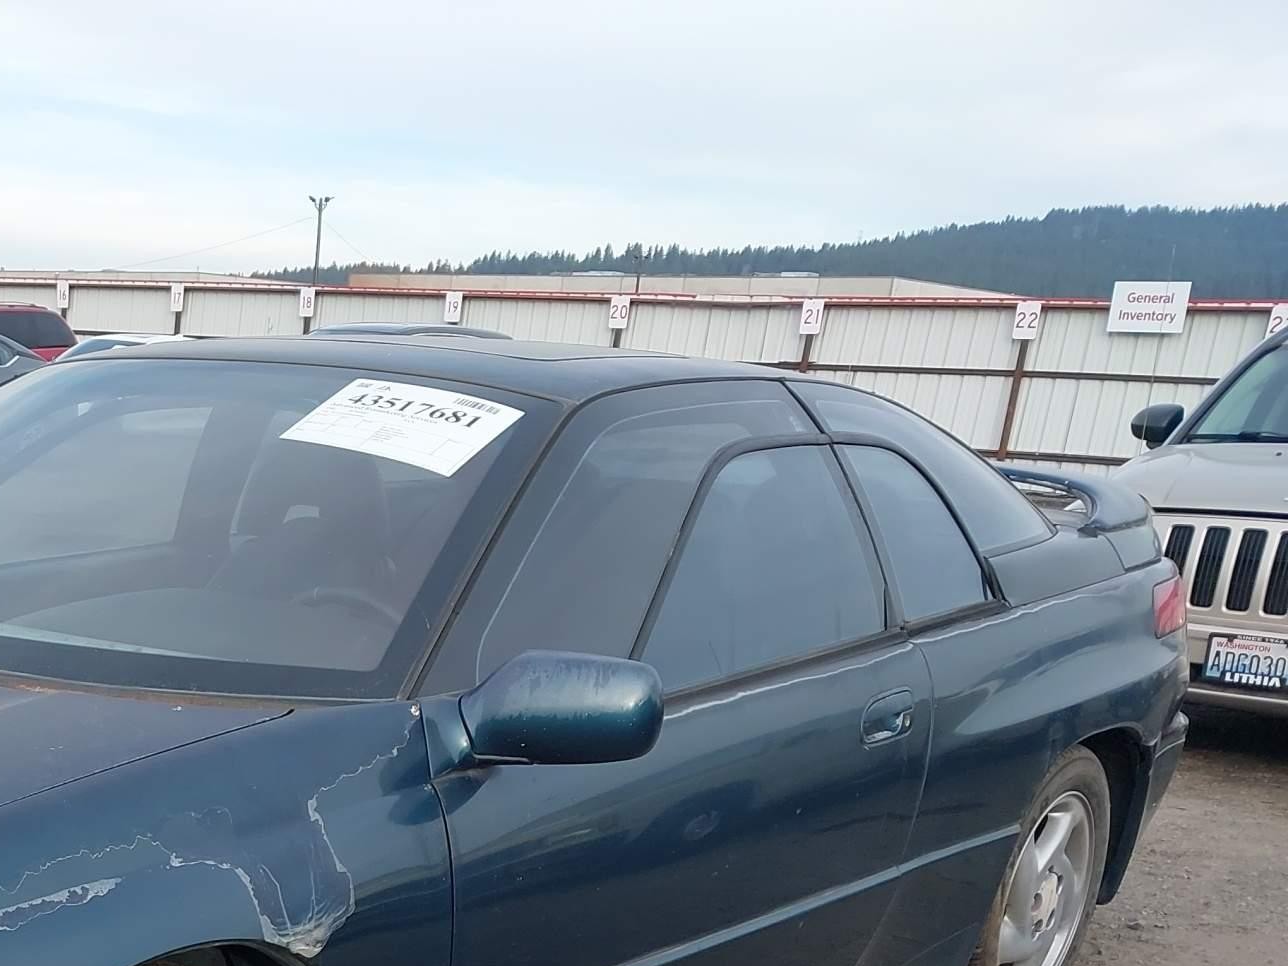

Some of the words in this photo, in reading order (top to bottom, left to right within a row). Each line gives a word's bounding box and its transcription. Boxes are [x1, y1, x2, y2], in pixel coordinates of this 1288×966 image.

[59, 289, 67, 301] 16
[173, 291, 182, 305] 17
[302, 296, 312, 309] 18
[1127, 291, 1175, 304] General
[447, 300, 459, 313] 19
[610, 304, 628, 319] 20
[803, 308, 820, 325] 21
[1015, 311, 1039, 329] 22
[1118, 309, 1177, 324] Inventory
[1269, 315, 1288, 334] 2
[347, 393, 482, 428] 43517681
[1216, 640, 1271, 653] WASHINGTON
[1224, 671, 1281, 688] LITHIA
